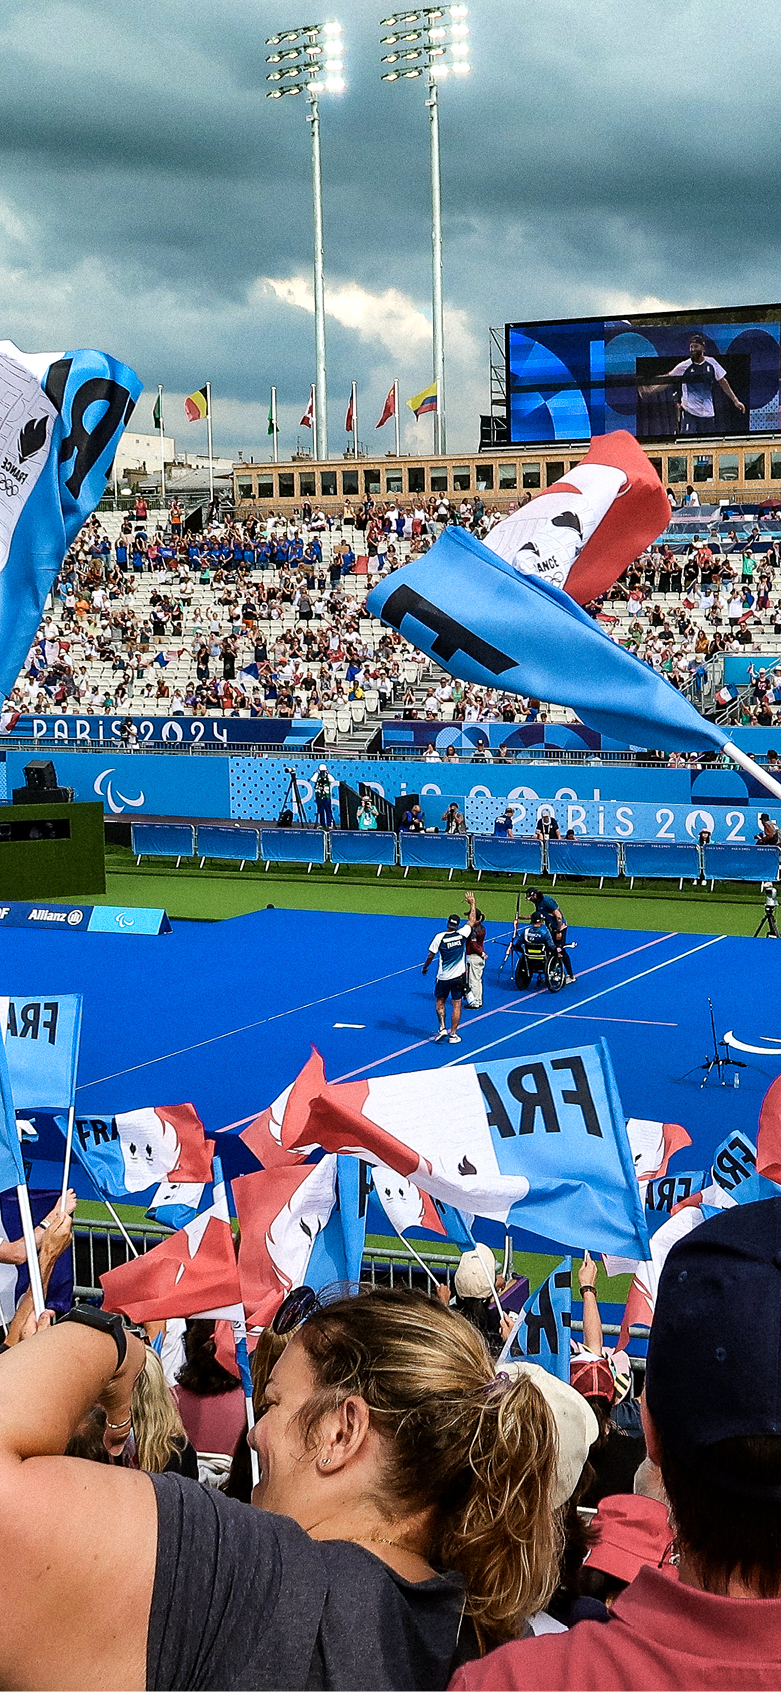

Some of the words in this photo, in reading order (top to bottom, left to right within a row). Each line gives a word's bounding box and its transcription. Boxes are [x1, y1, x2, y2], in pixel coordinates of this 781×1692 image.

[533, 555, 560, 573] ANCE
[139, 721, 228, 748] 2024
[28, 909, 68, 922] Allianz
